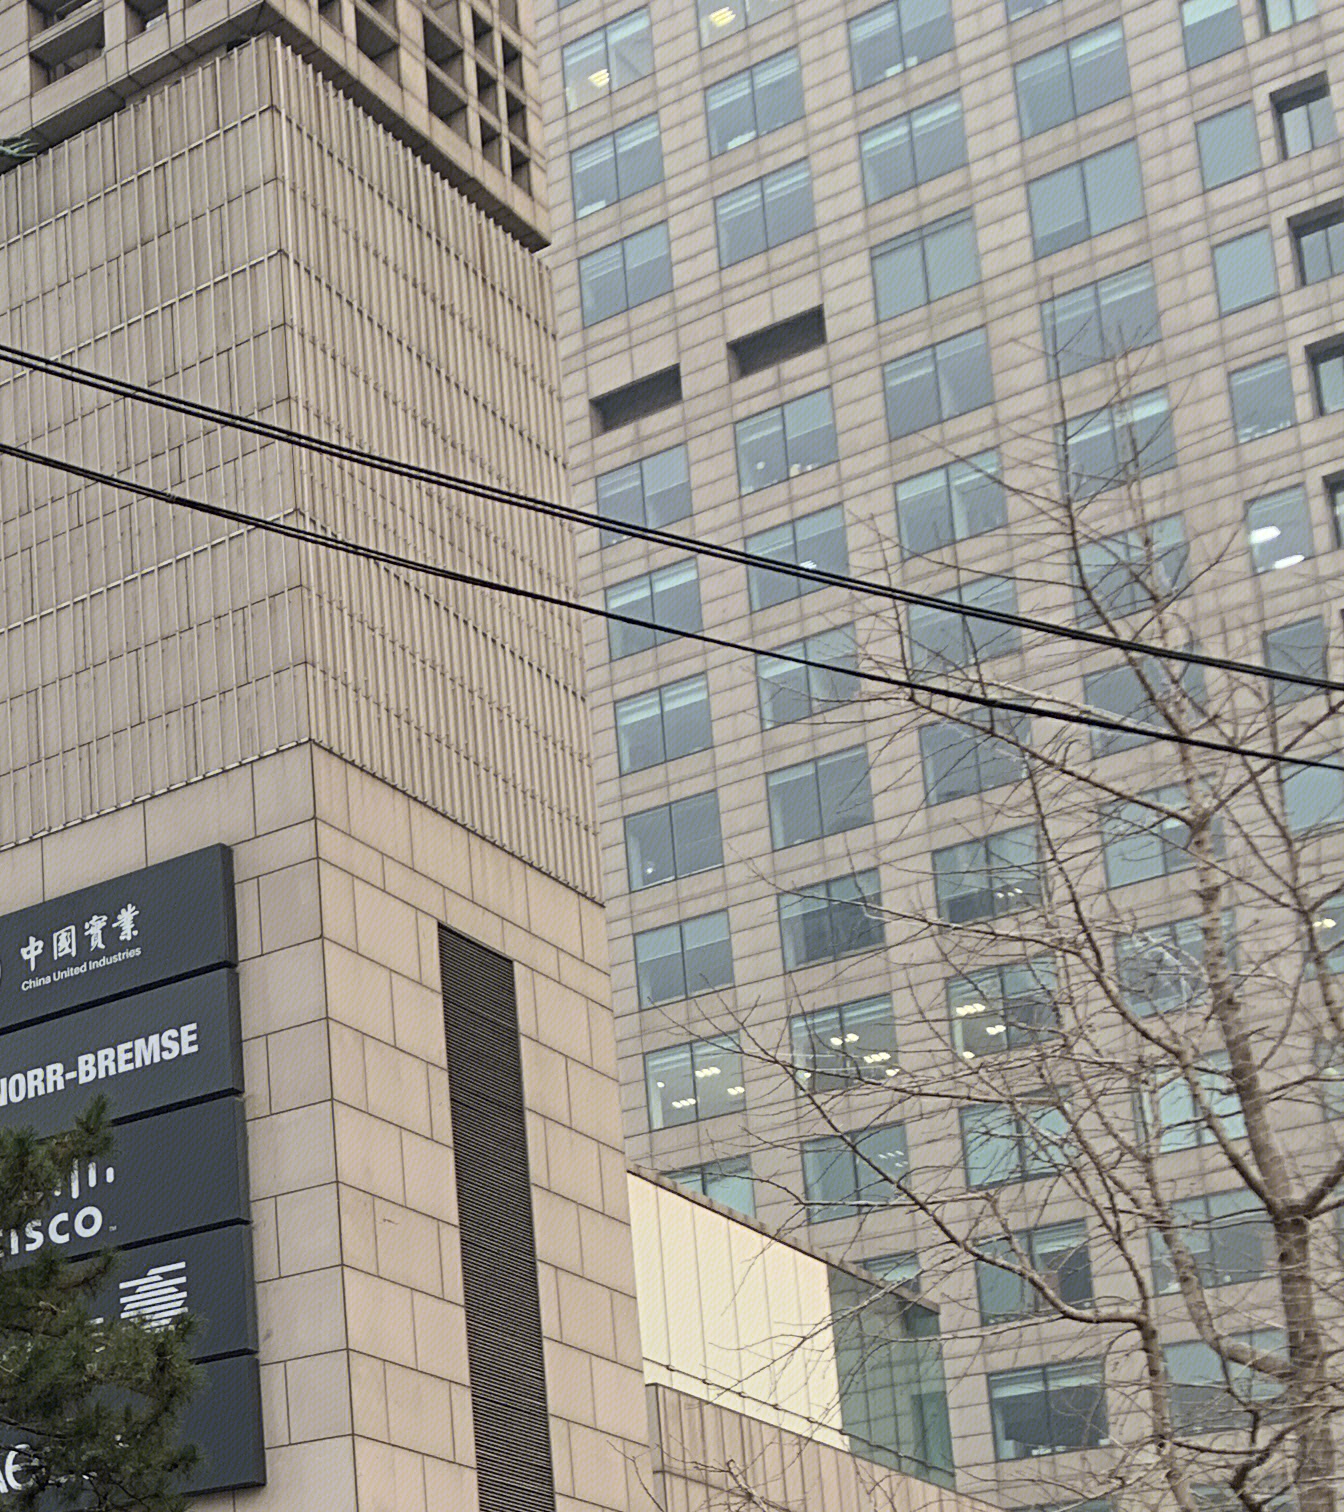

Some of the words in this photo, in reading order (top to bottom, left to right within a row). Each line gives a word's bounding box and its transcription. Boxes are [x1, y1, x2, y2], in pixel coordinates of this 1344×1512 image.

[20, 903, 139, 972] 中國實業
[21, 975, 51, 991] China
[53, 962, 87, 982] United
[89, 947, 142, 971] Industries
